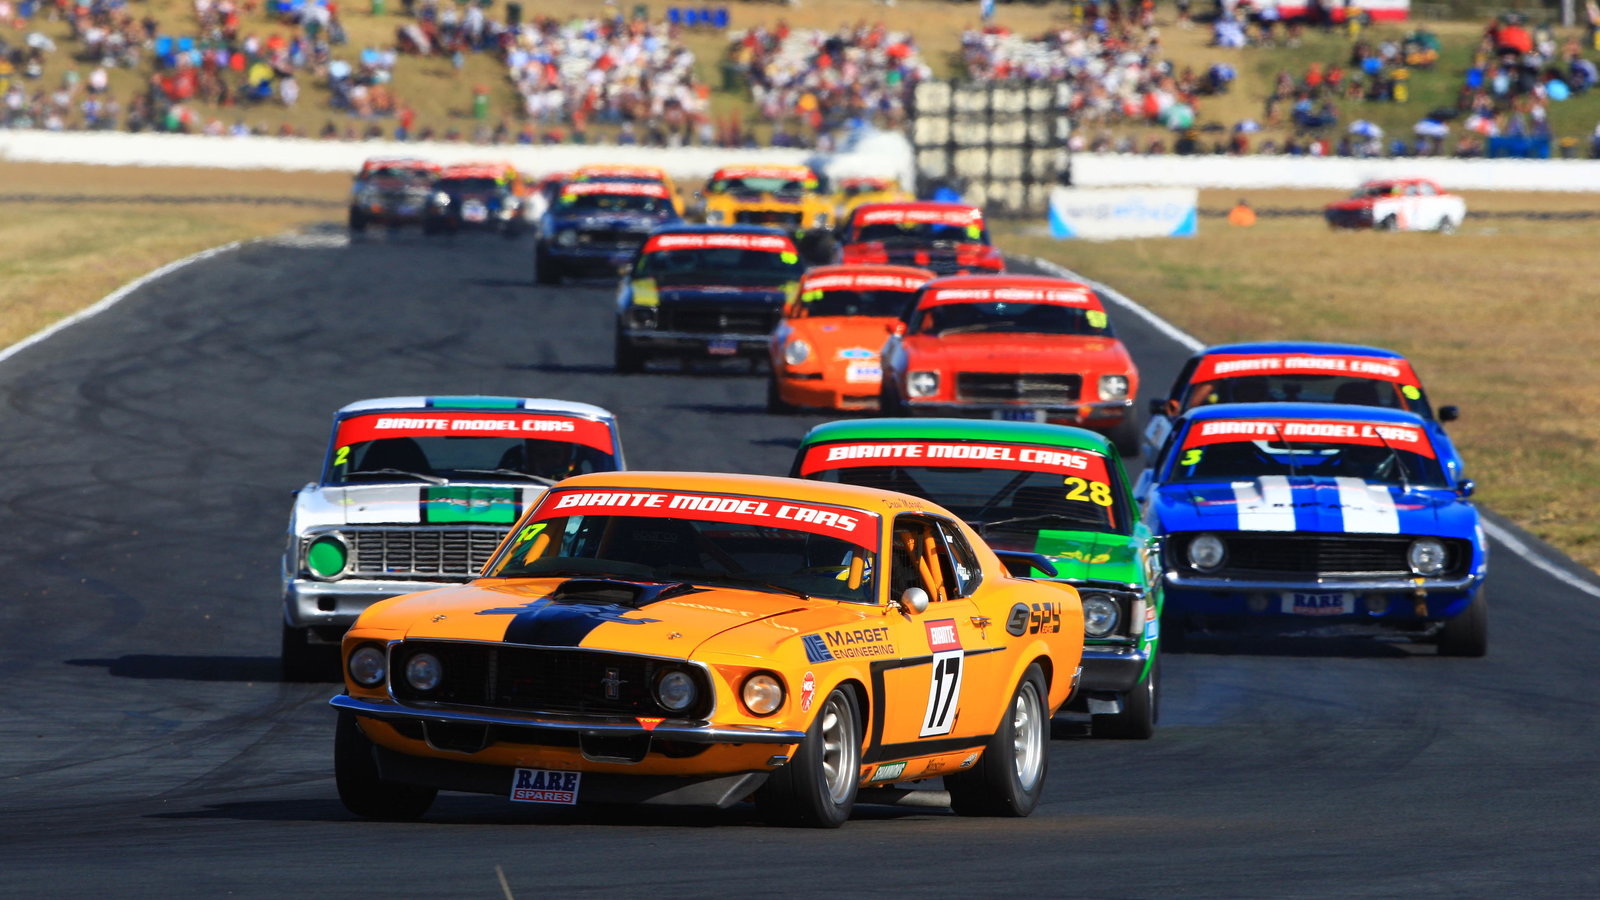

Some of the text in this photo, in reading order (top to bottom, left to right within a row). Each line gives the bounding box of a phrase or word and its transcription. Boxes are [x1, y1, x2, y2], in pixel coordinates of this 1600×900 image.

[374, 418, 575, 432] BIANTE MODEL CARS
[1201, 421, 1419, 443] BIANTE MODEL CARS
[334, 446, 350, 466] 2
[826, 445, 1088, 470] BIANTE MODEL CARS
[1180, 449, 1203, 466] 3
[1064, 476, 1113, 507] 28
[553, 493, 859, 532] BIANTE MODEL CARS
[516, 523, 548, 543] 17
[1029, 602, 1062, 635] SPY
[825, 627, 888, 647] MARGET
[930, 625, 957, 645] BIANTE
[833, 644, 895, 659] ENGINEERING
[927, 657, 960, 729] 17
[515, 769, 578, 792] RARE
[515, 790, 572, 802] SPARES
